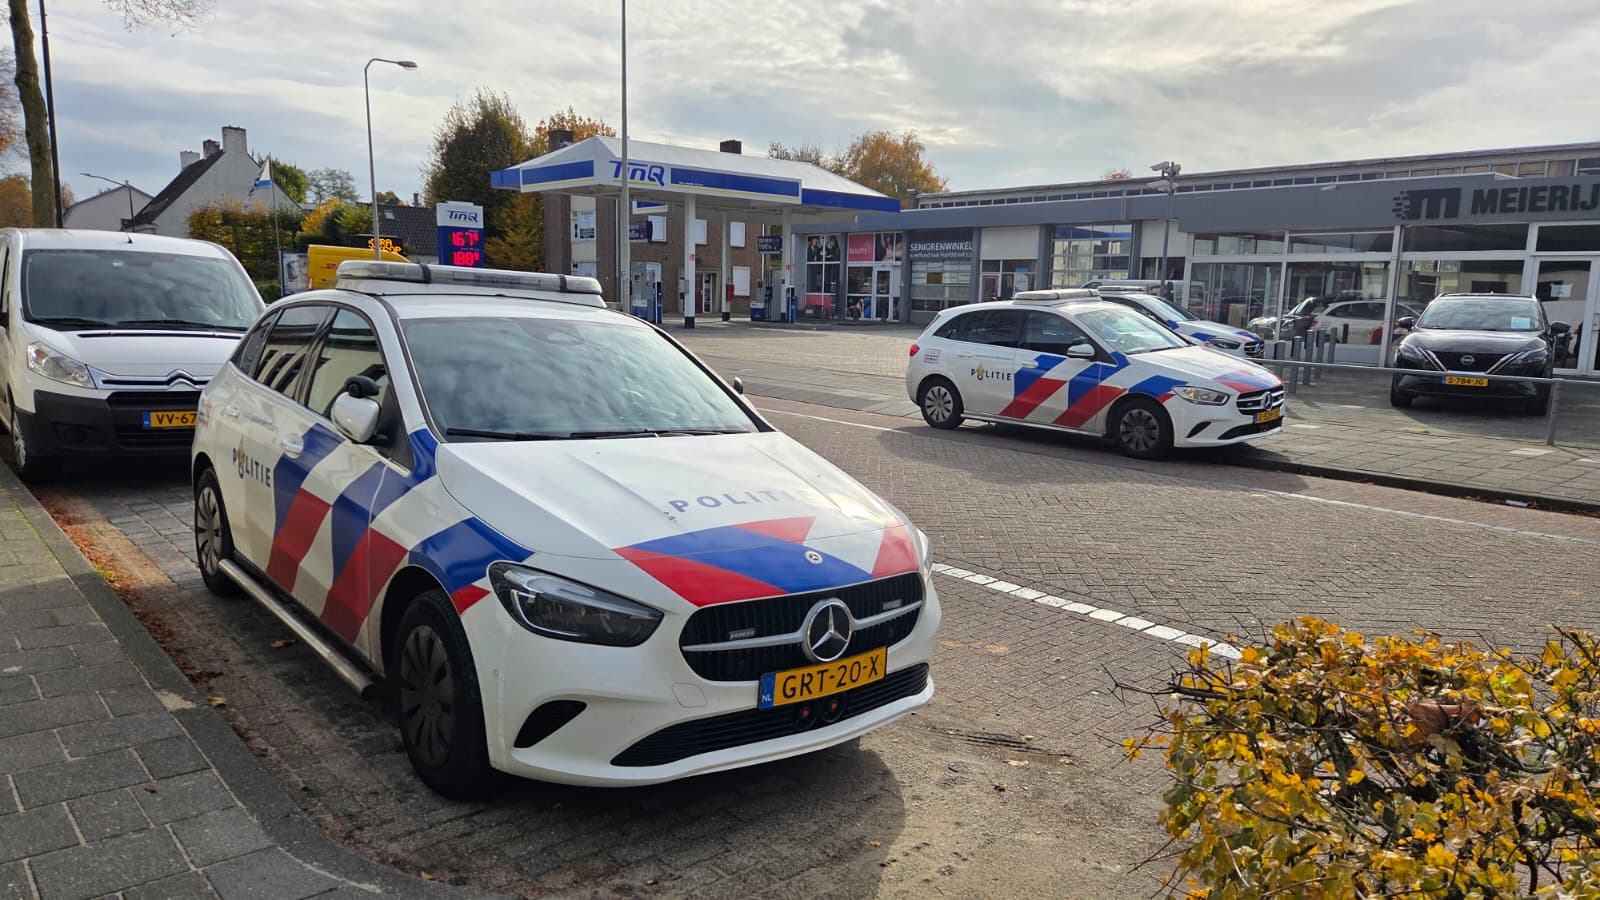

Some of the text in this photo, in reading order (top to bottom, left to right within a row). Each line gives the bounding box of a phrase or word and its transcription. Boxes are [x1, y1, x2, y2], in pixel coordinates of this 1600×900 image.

[609, 160, 665, 186] TnQ
[1471, 184, 1600, 215] MEIERIJ
[447, 210, 479, 223] TinQ
[910, 242, 973, 252] SENIORENWINKEL
[970, 367, 1013, 381] POLITIE
[232, 447, 271, 488] POLITIE
[761, 653, 880, 702] NL GRT-20-X
